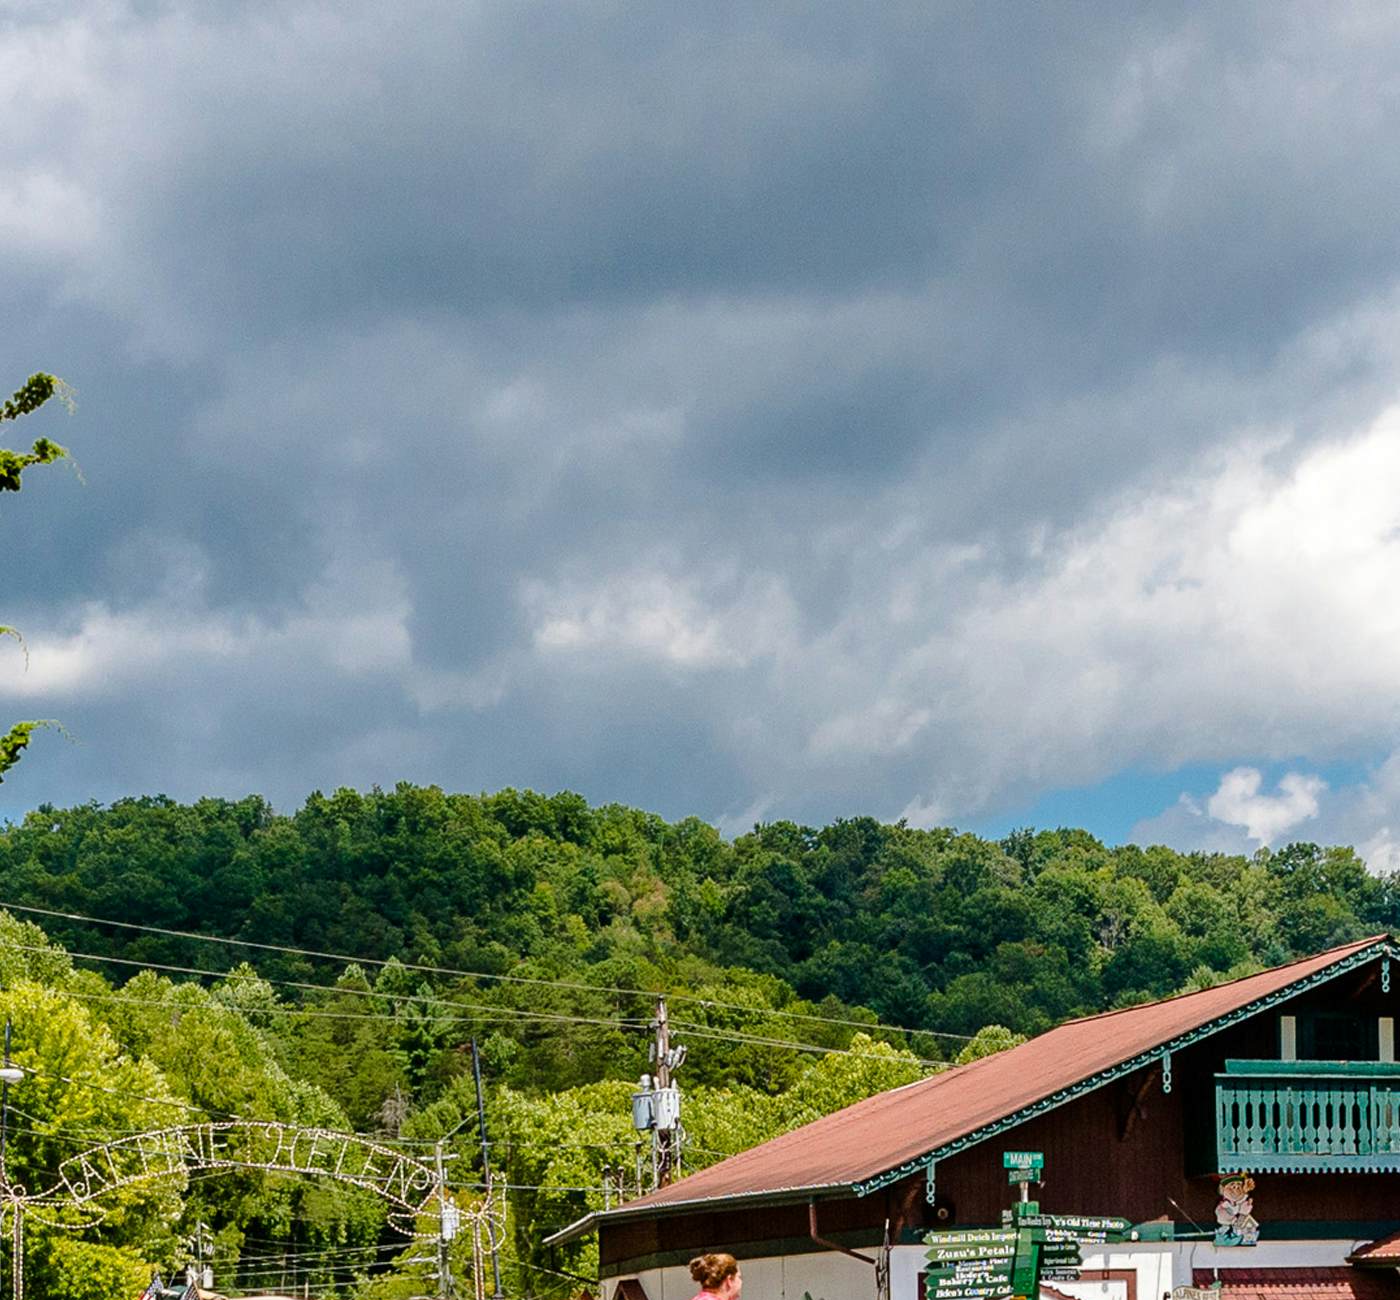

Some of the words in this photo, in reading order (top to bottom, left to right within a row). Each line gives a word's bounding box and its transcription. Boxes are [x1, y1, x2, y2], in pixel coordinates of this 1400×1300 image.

[75, 1126, 227, 1199] ALPINE
[265, 1126, 431, 1200] HELEN
[1010, 1152, 1032, 1166] MAIN
[1066, 1219, 1080, 1227] Old
[1081, 1219, 1100, 1227] Time
[1102, 1219, 1124, 1228] Photo
[931, 1233, 966, 1243] Windmill
[967, 1233, 990, 1242] Dutch
[991, 1232, 1021, 1243] Imports
[937, 1248, 976, 1259] Zuzu's
[979, 1245, 1015, 1257] Petals
[939, 1277, 974, 1287] Bakery
[964, 1287, 995, 1297] Country
